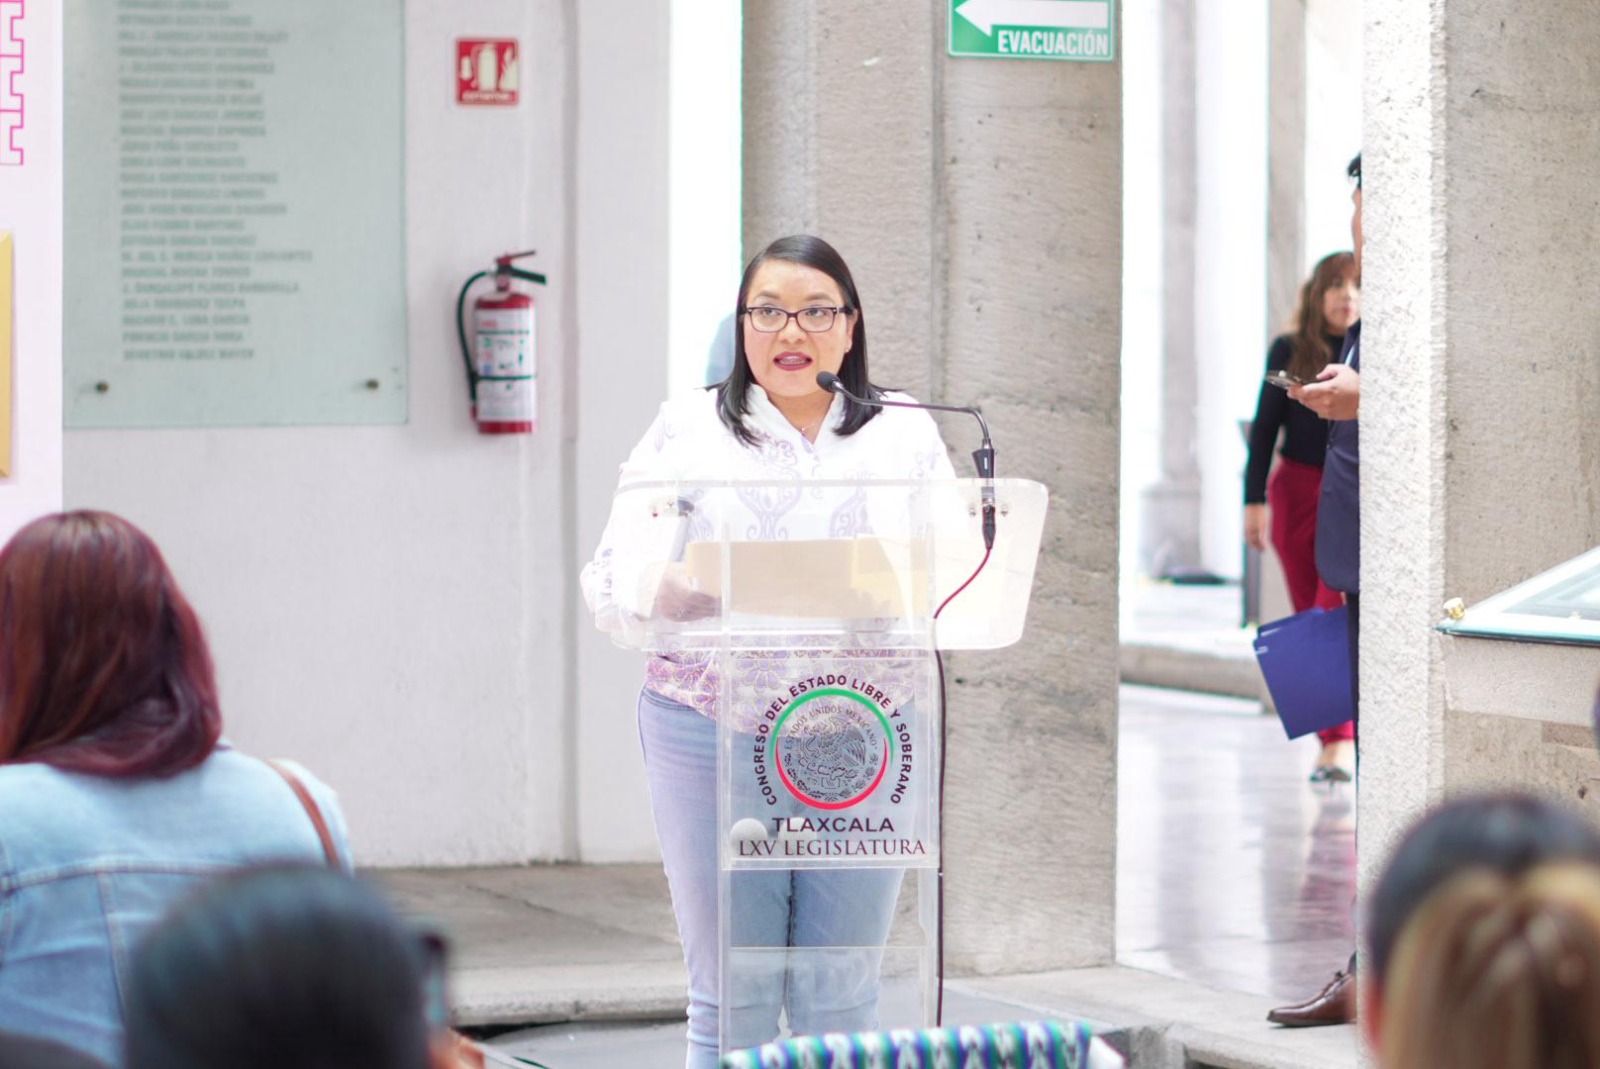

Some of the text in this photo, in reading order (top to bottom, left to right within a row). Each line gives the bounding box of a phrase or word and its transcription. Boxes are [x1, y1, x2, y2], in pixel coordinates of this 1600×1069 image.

[998, 29, 1108, 55] EVACUACIÓN
[753, 674, 913, 806] CONGRESO DEL ESTADO LIBRE Y SOBERANO
[772, 817, 895, 832] TLAXCALA
[739, 838, 926, 856] LXV LEGISLATURA
